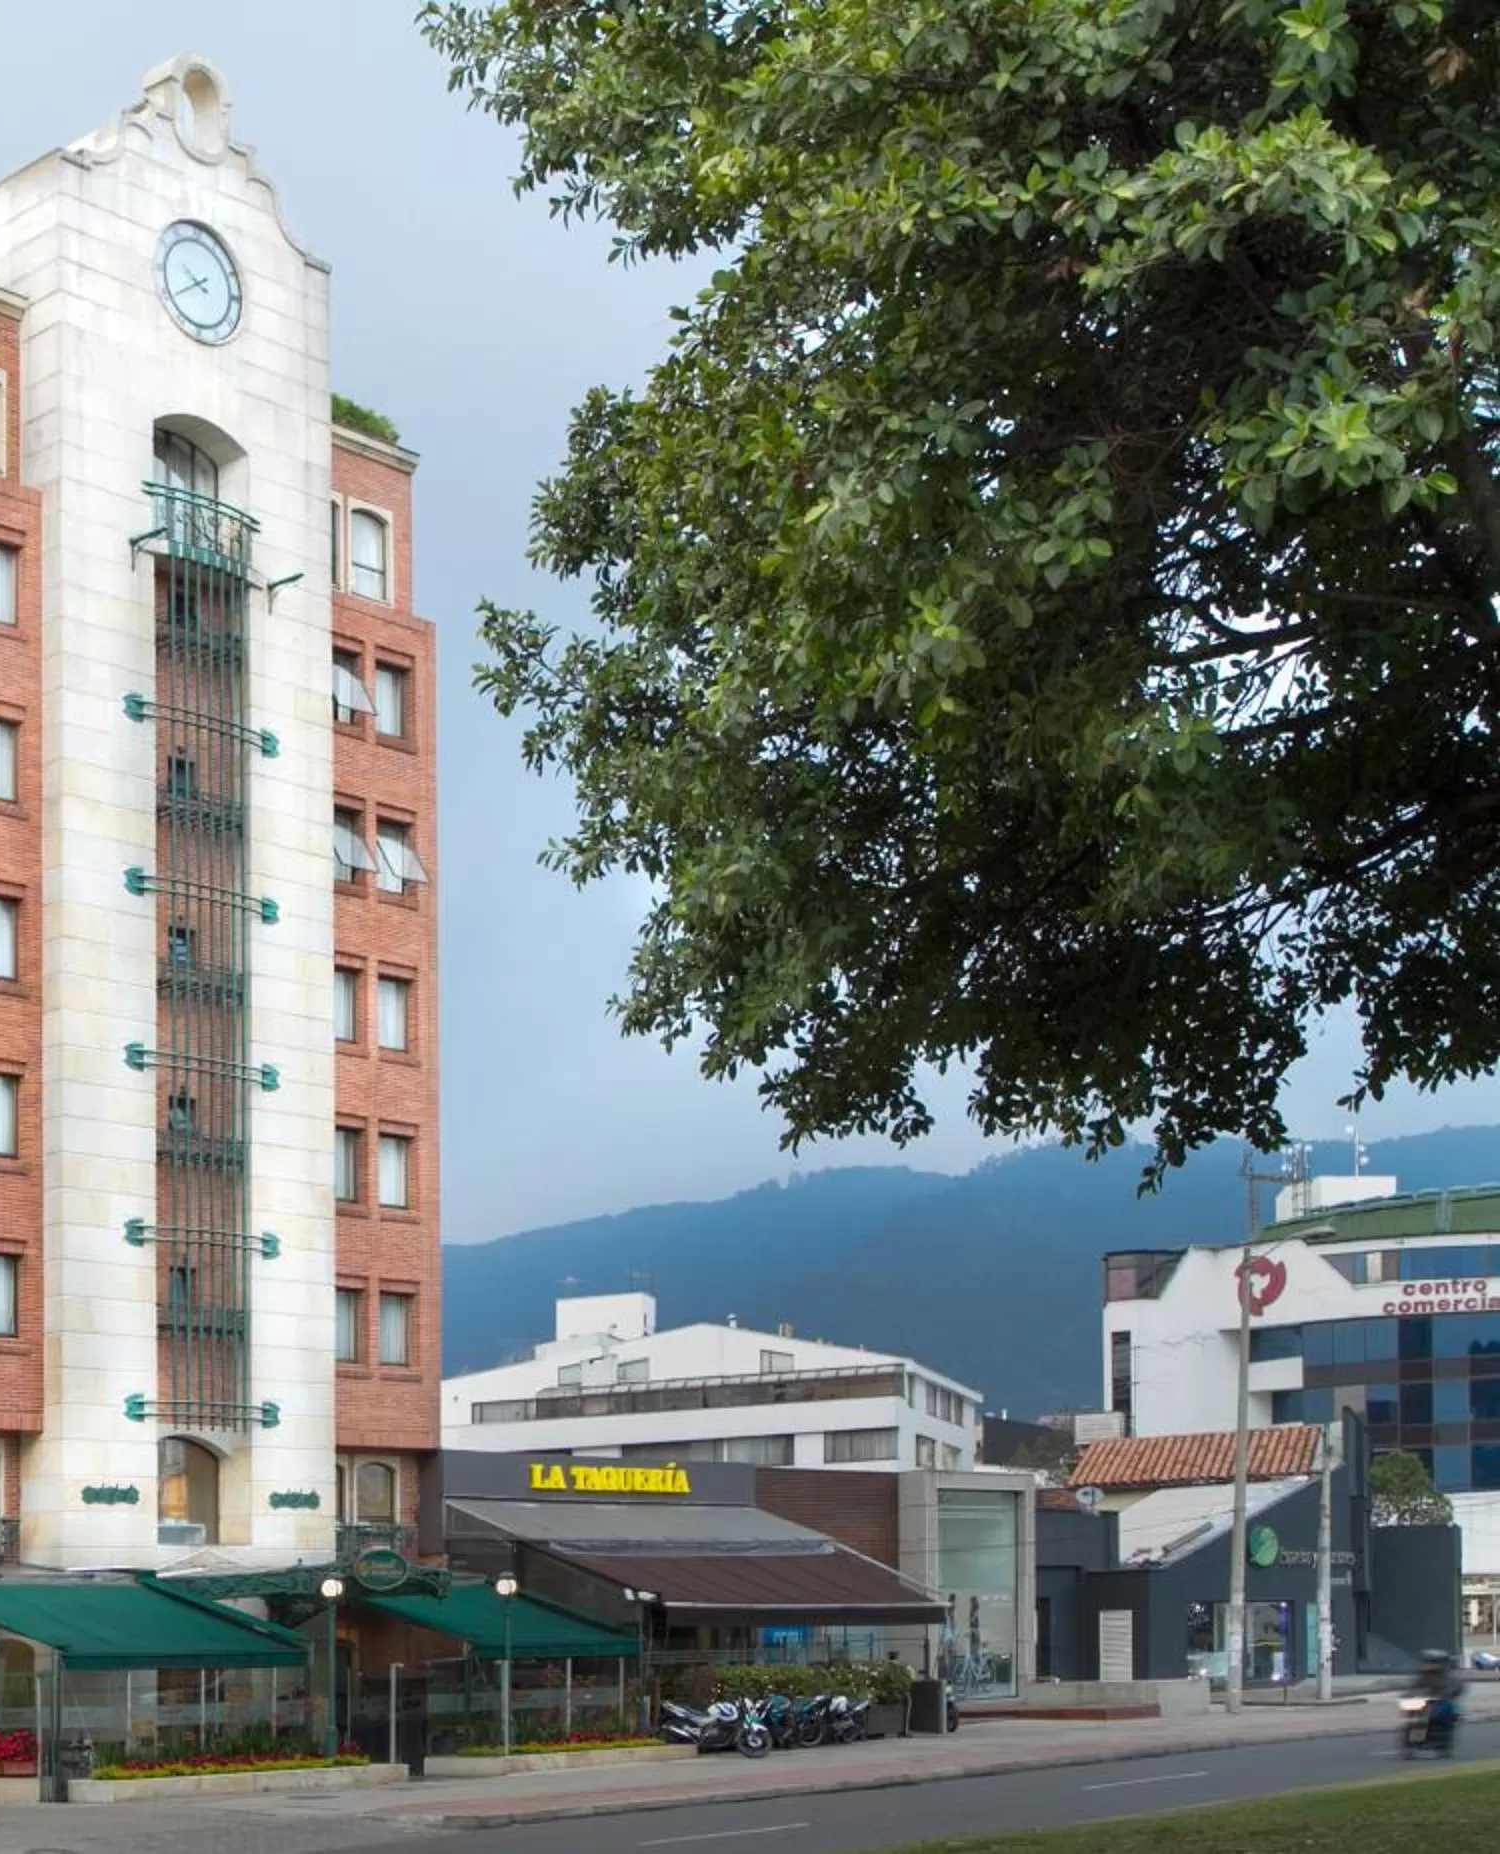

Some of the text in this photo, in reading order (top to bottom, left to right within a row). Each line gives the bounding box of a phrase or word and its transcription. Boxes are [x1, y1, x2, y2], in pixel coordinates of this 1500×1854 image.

[1403, 1279, 1487, 1296] centro
[530, 1461, 692, 1494] LA TAQUERÍA
